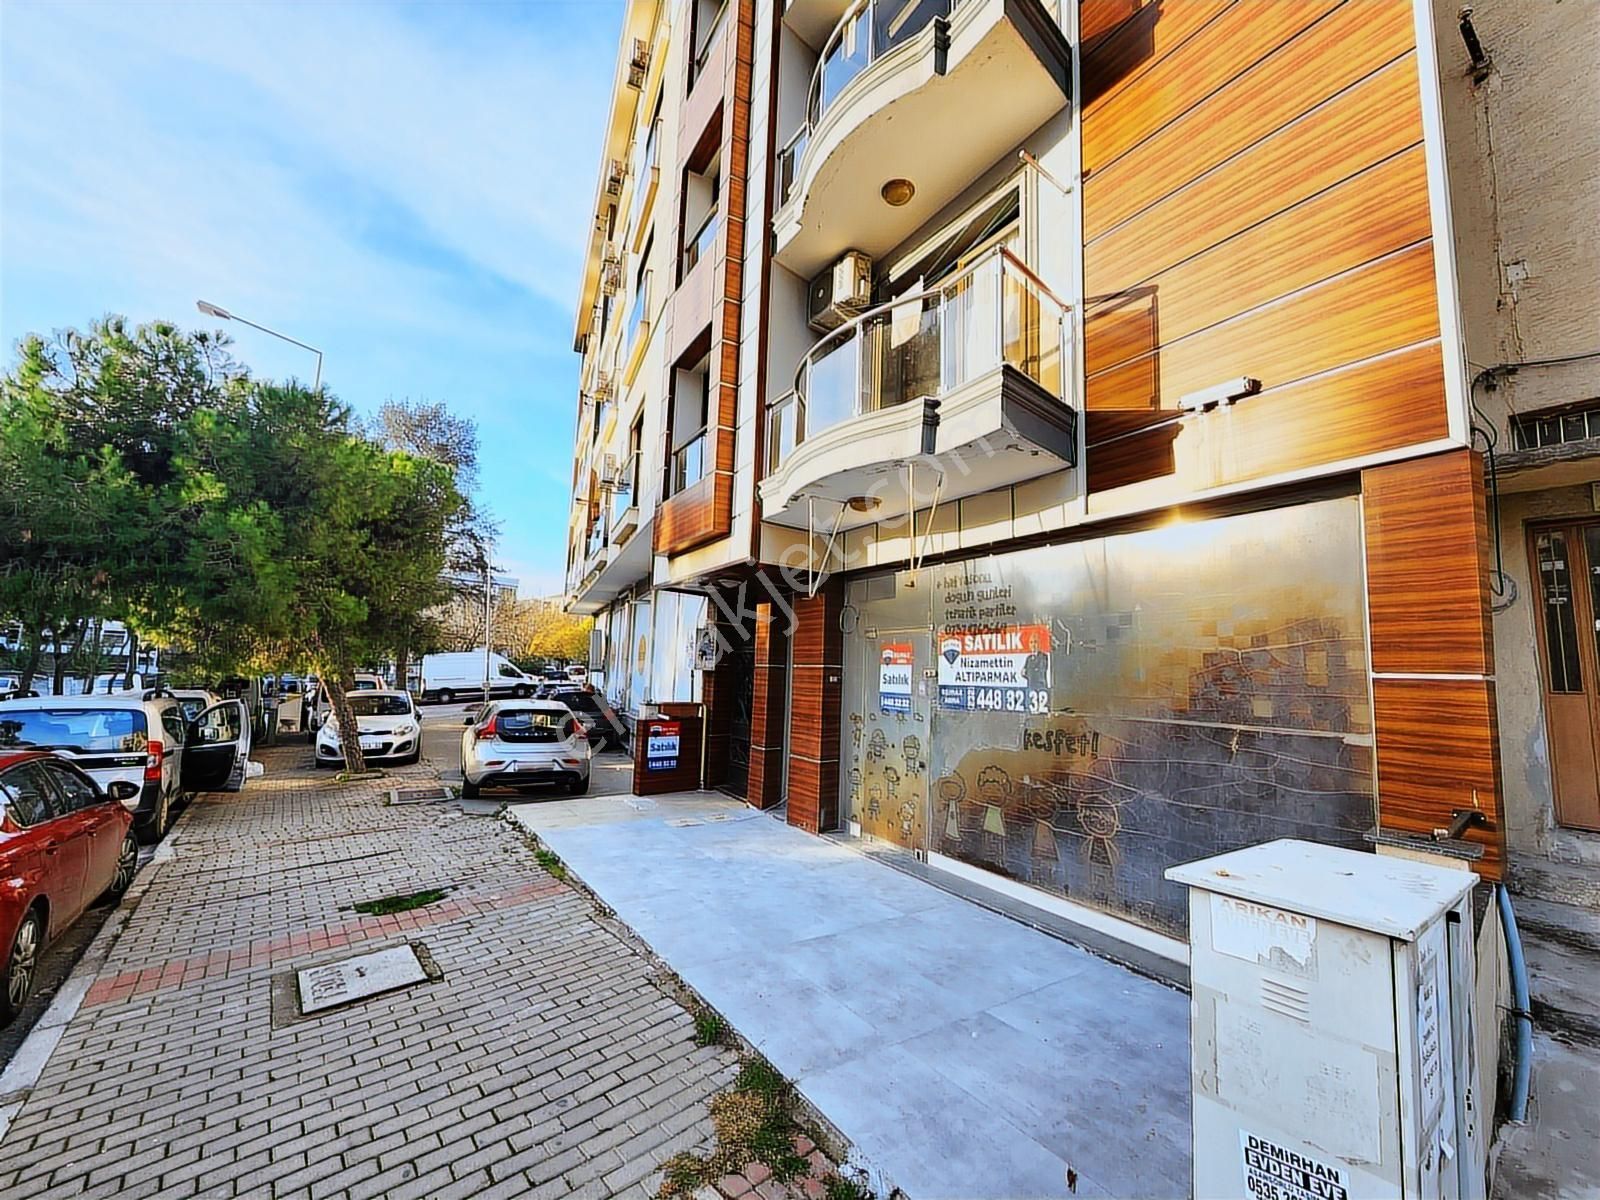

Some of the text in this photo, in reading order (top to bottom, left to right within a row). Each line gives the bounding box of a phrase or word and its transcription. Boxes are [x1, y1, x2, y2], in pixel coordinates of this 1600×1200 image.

[960, 657, 1014, 669] Nizamettin
[955, 671, 1018, 683] ALTIPARMAK
[977, 689, 1002, 711] 448
[1249, 1150, 1346, 1200] EVDEN EVE
